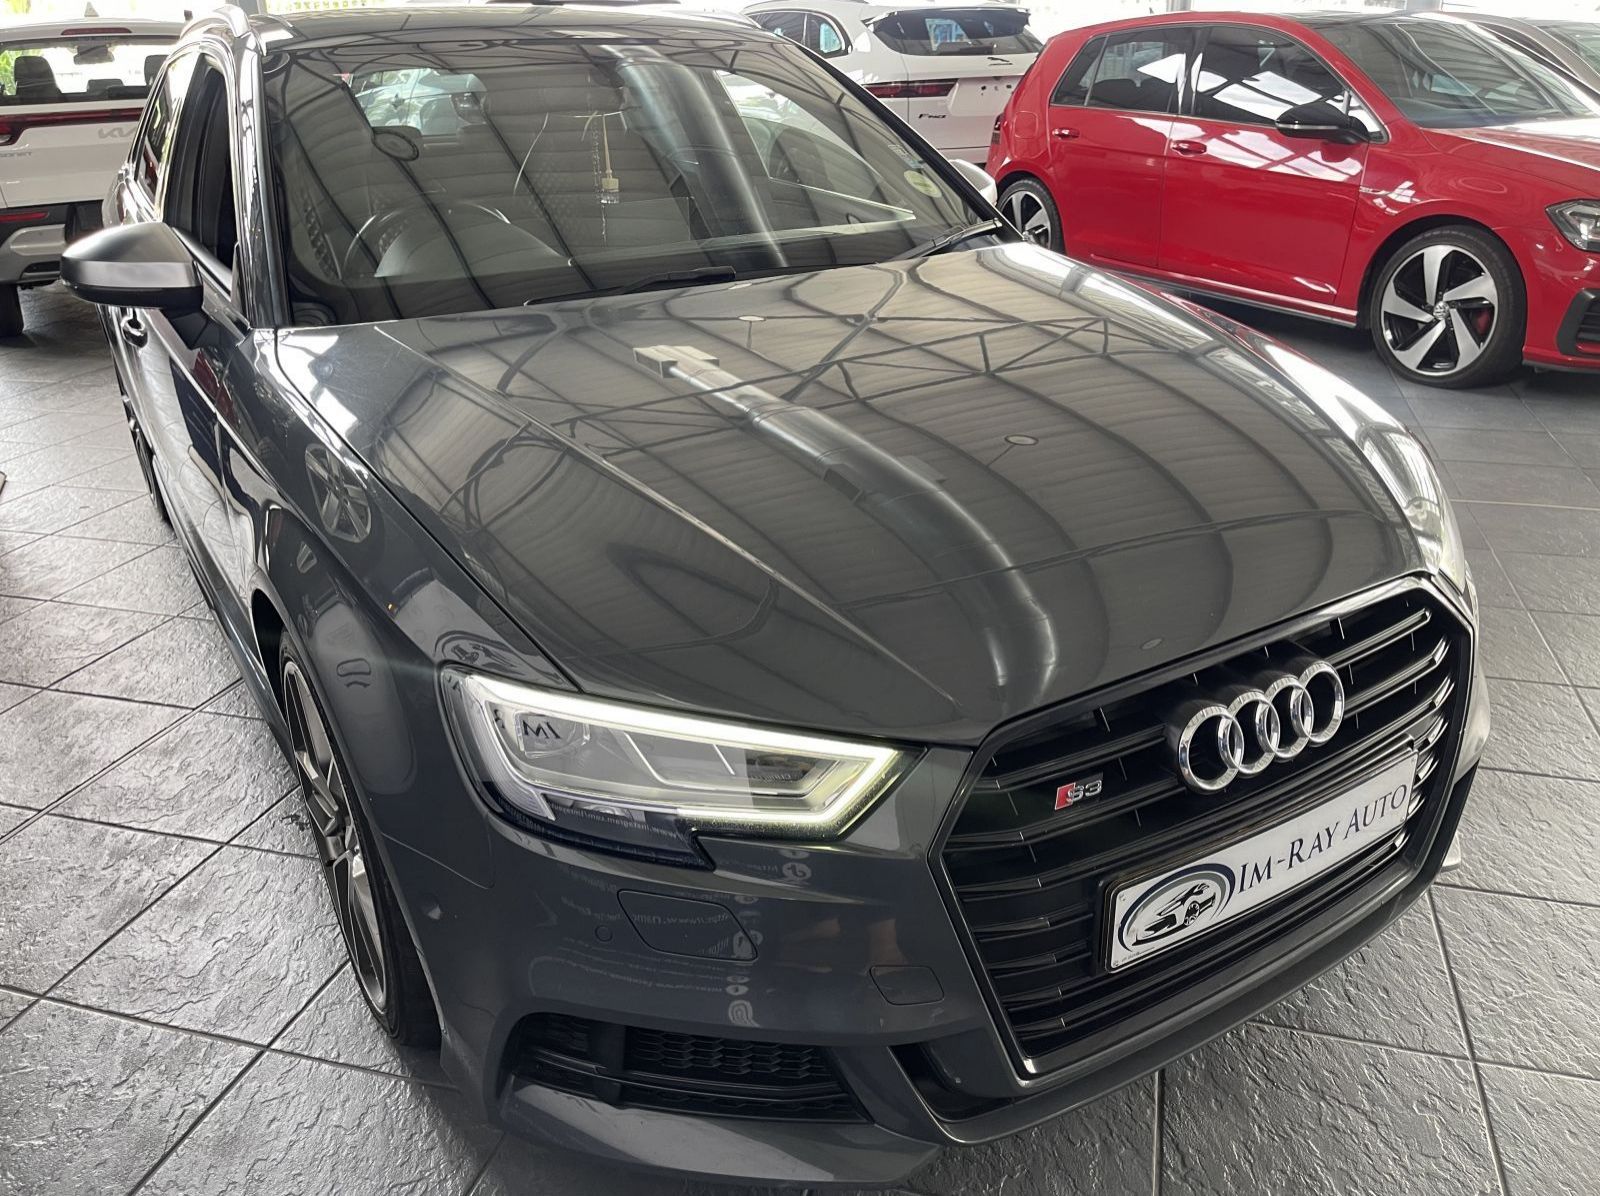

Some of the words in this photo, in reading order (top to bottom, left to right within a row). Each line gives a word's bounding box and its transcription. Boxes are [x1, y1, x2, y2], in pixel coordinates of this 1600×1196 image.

[1066, 779, 1103, 803] S3
[1237, 820, 1341, 895] IM-RAY
[1342, 783, 1408, 841] AUTO
